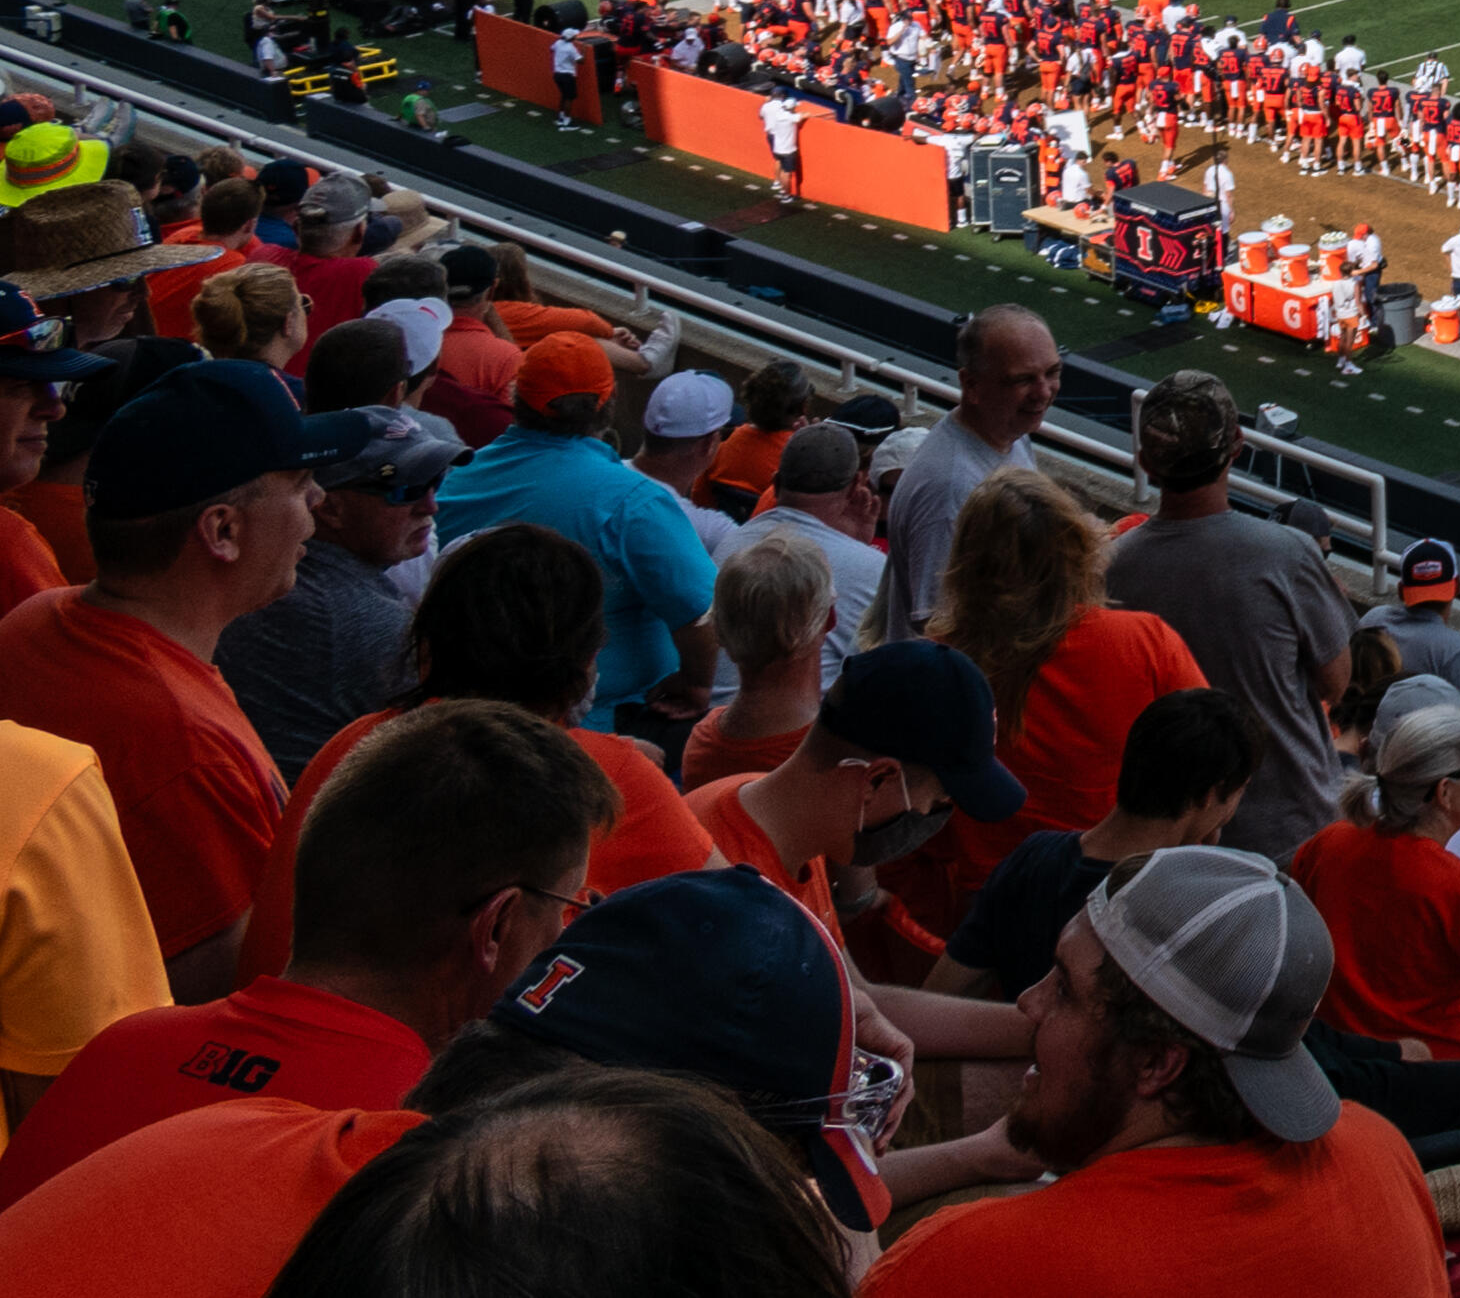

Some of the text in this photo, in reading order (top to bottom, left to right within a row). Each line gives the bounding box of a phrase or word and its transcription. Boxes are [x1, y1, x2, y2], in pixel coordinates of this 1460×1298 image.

[1230, 282, 1247, 313] G
[1283, 299, 1301, 330] G
[516, 954, 586, 1015] I
